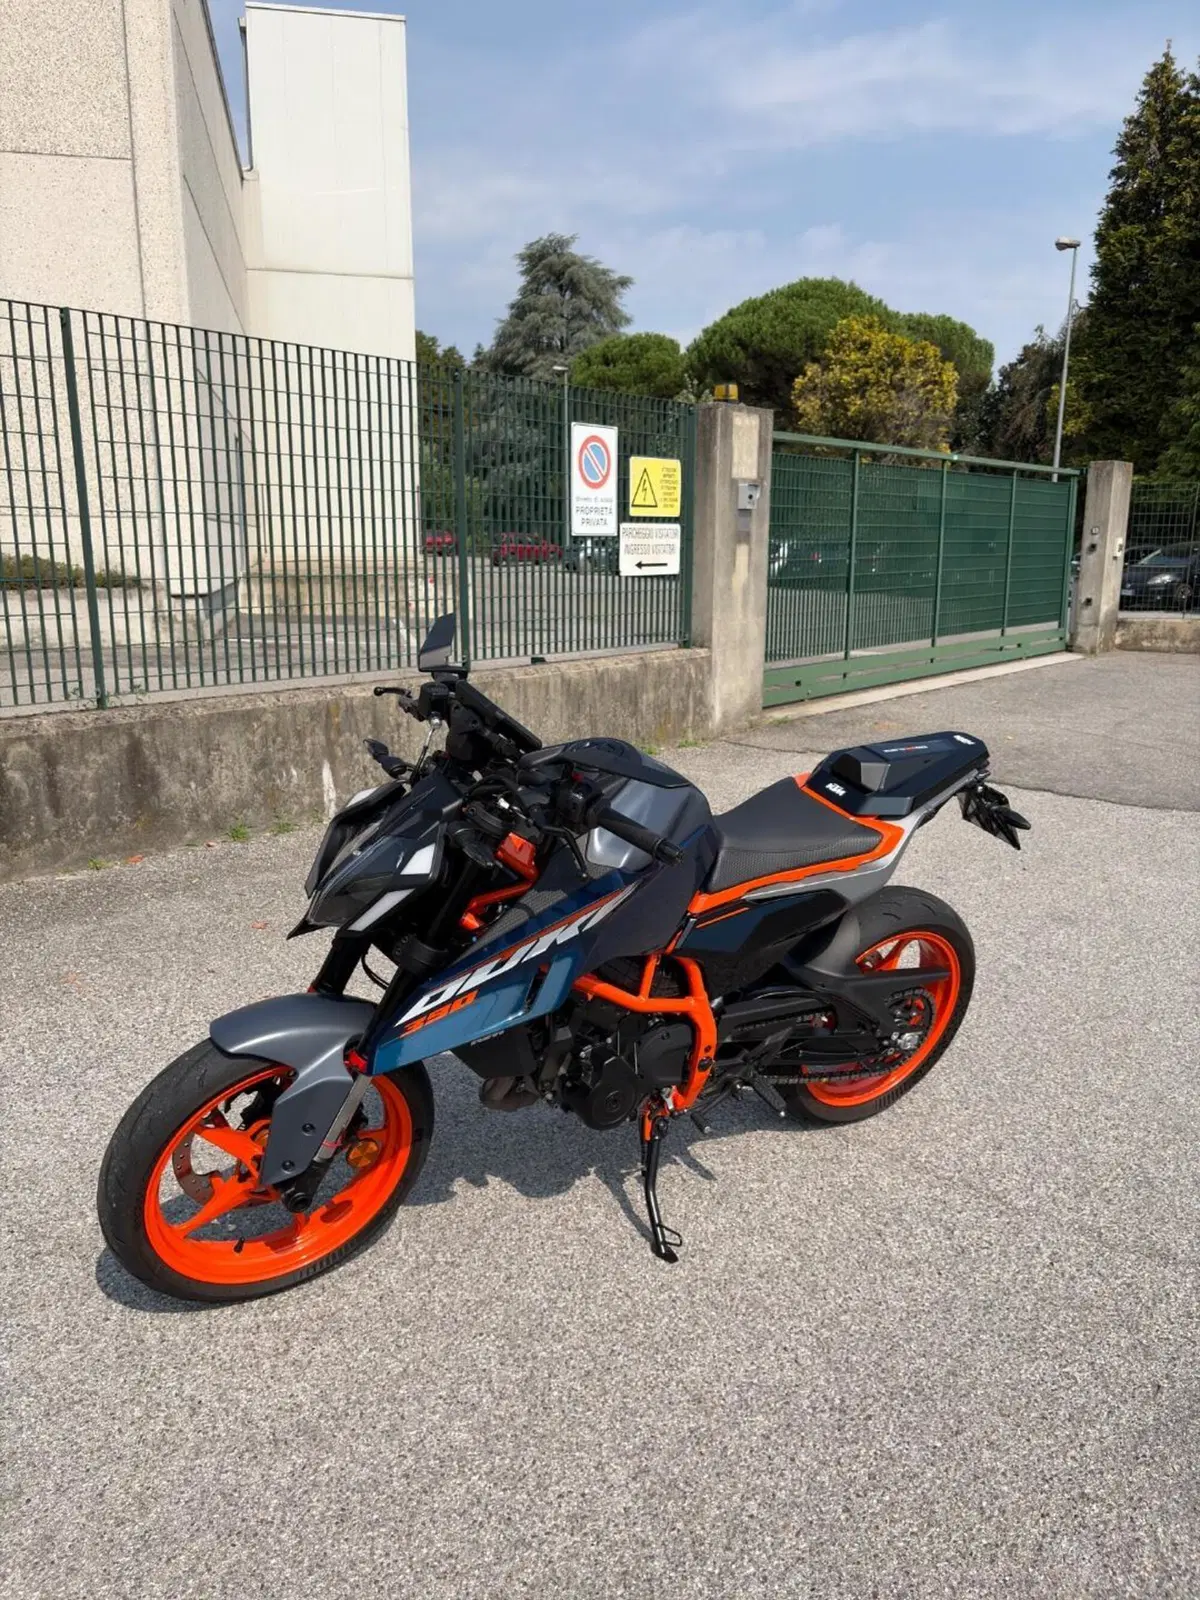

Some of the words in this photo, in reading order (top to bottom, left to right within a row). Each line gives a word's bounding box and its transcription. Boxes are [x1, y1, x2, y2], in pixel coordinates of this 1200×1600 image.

[581, 517, 609, 527] PRIVATA
[825, 782, 846, 797] KTM
[398, 989, 480, 1039] 390
